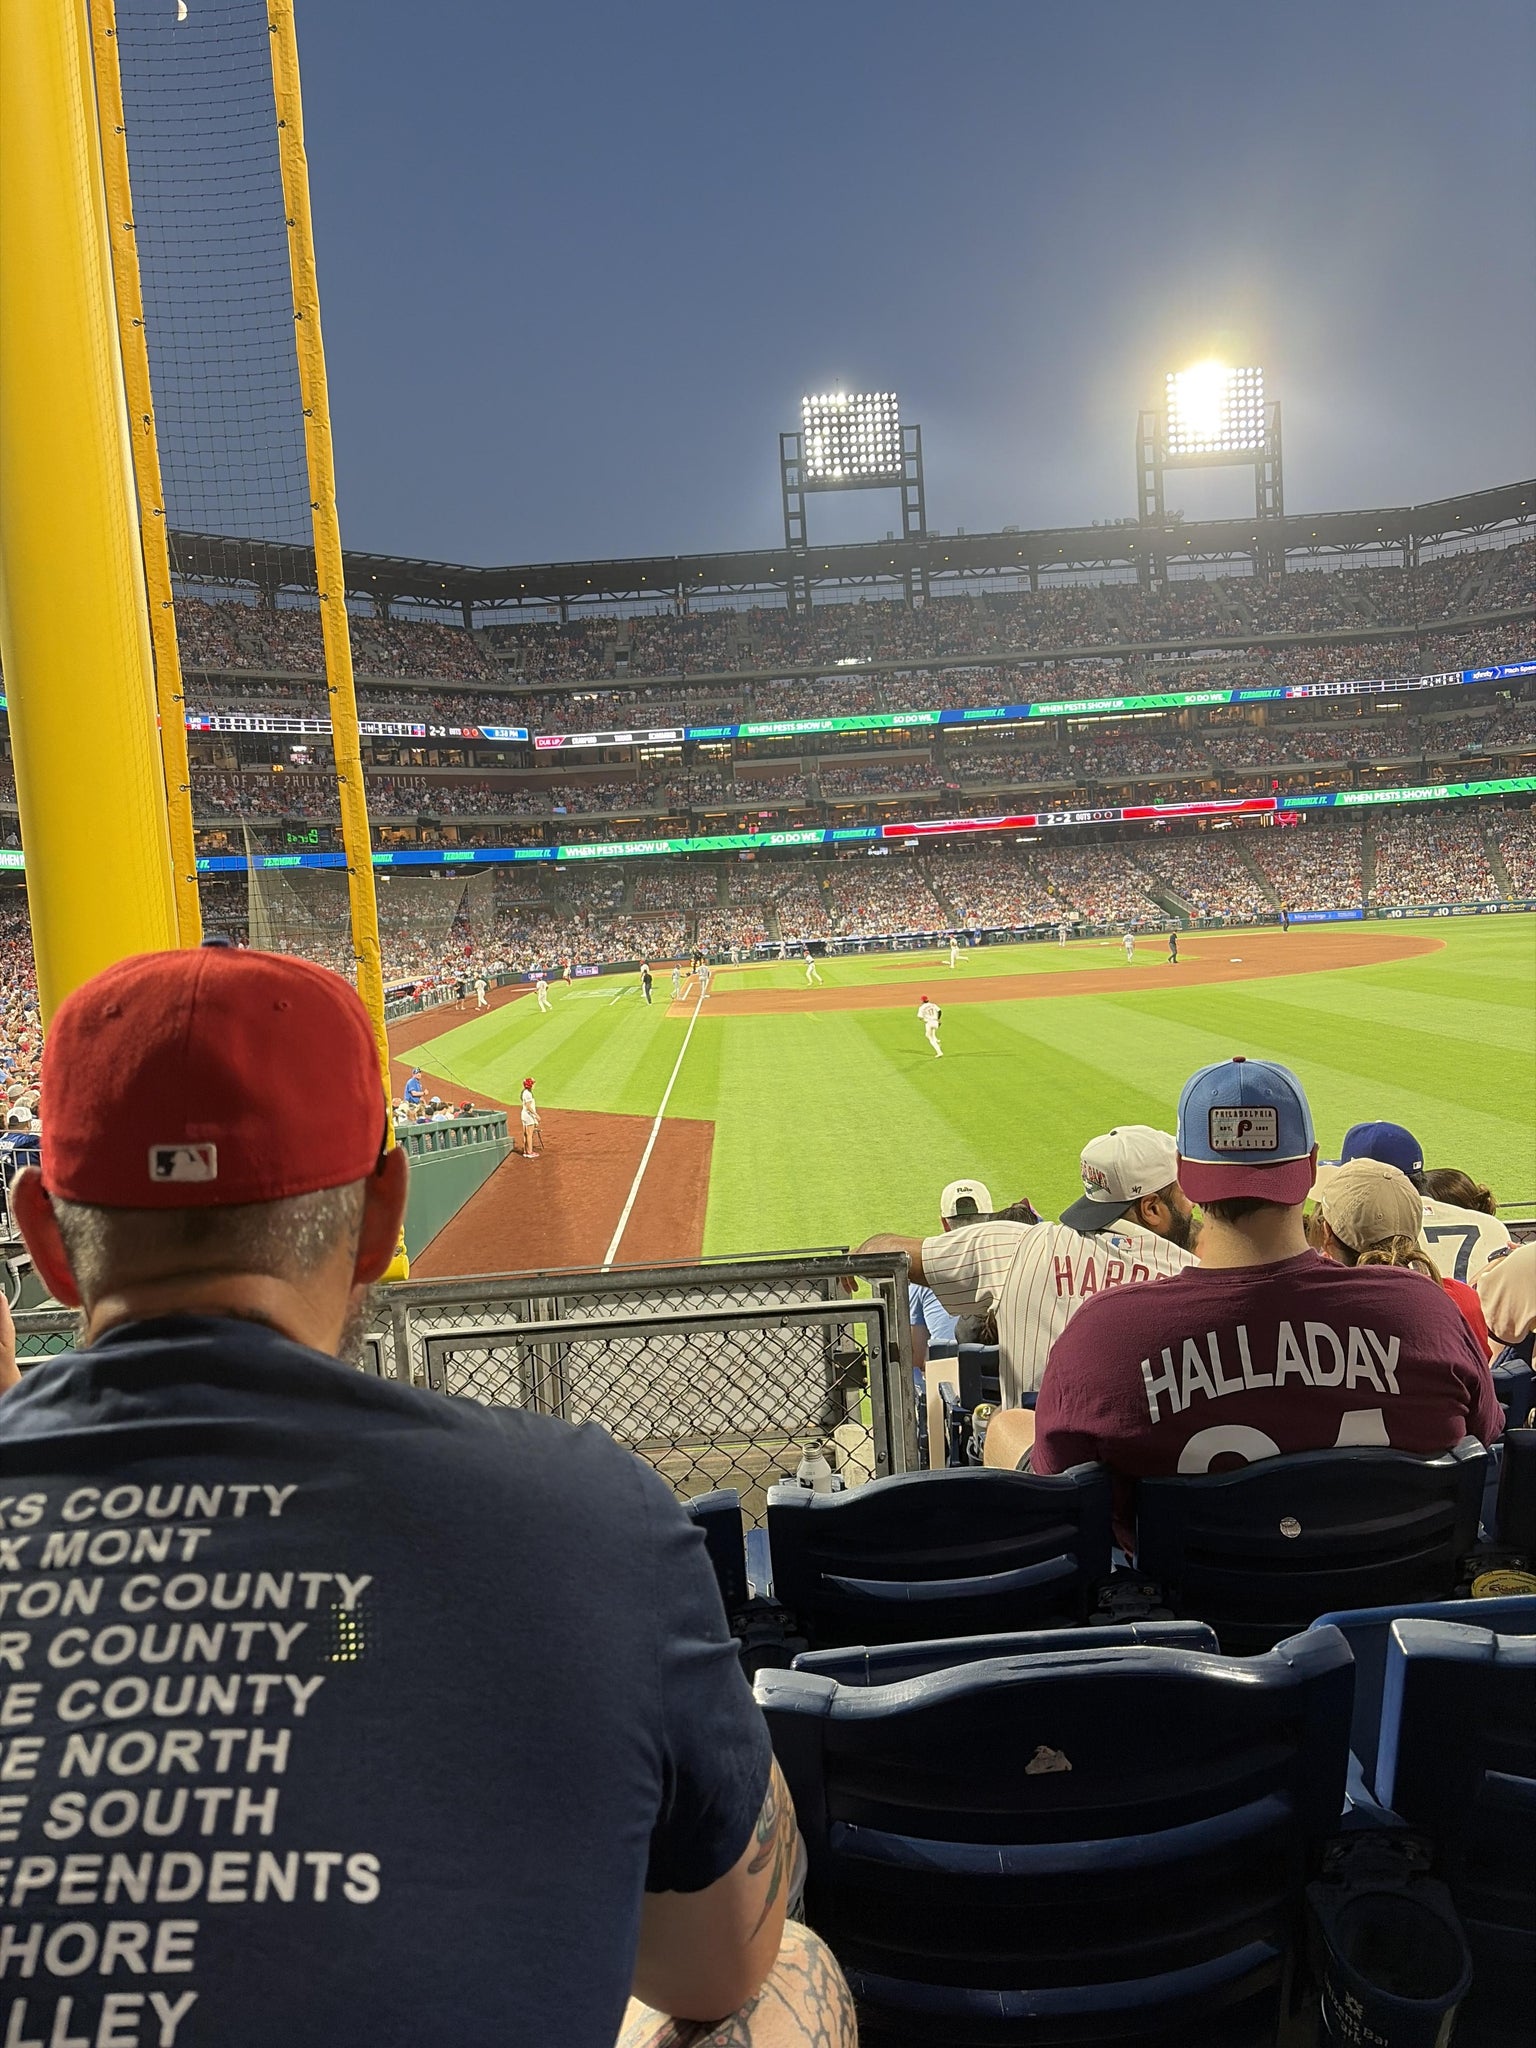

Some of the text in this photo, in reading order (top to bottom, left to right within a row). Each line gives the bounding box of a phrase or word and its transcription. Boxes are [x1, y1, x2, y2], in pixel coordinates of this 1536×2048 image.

[1039, 704, 1064, 713] WHEN
[1087, 702, 1112, 710] SHOW
[893, 716, 904, 724] SO
[430, 726, 446, 736] 2-2
[748, 725, 772, 734] WHEN
[773, 724, 795, 732] PESTS
[795, 722, 820, 731] SHOW
[232, 774, 248, 788] OF
[1344, 794, 1373, 803] WHEN
[1374, 791, 1402, 801] PESTS
[1402, 789, 1433, 799] SHOW
[770, 832, 820, 844] SO DO WE.
[566, 848, 596, 856] WHEN
[599, 846, 625, 854] PESTS
[626, 844, 654, 852] SHOW
[1391, 910, 1402, 918] 10
[1438, 908, 1449, 916] 10
[1486, 904, 1497, 913] 10
[1215, 1110, 1272, 1118] PHILADELPHIA
[1422, 1224, 1481, 1284] 7
[1141, 1321, 1401, 1424] HALLADAY
[62, 1485, 298, 1521] COUNTY
[41, 1528, 212, 1568] MONT
[119, 1573, 373, 1612] COUNTY
[48, 1623, 308, 1668] COUNTY
[57, 1675, 325, 1722] COUNTY
[59, 1729, 291, 1778] NORTH
[44, 1787, 279, 1840] SOUTH
[0, 1920, 199, 1978] HORE
[5, 1991, 198, 2048] LLEY
